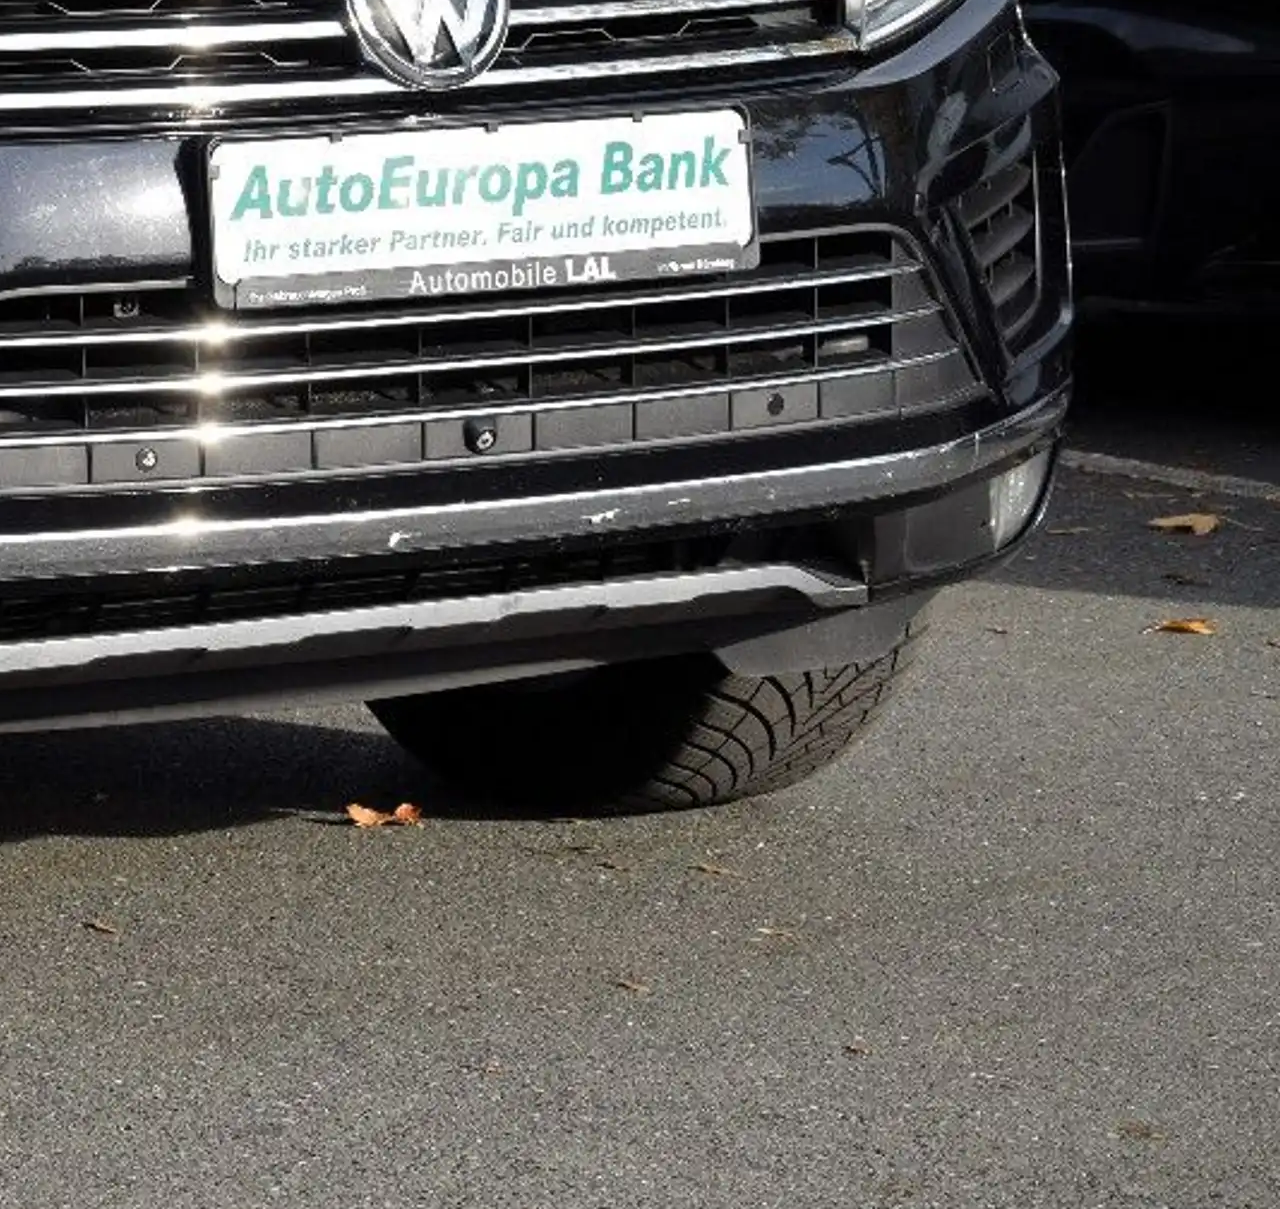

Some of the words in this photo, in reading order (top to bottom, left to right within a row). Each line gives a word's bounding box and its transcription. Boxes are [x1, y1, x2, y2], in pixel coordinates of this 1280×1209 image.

[229, 154, 581, 221] AutoEuropa
[600, 135, 732, 195] Bank
[243, 239, 281, 263] Ihr
[288, 234, 382, 261] starker
[390, 229, 488, 252] Partner.
[497, 220, 544, 244] Fair
[550, 215, 596, 240] und
[602, 207, 728, 239] kompetent.
[408, 263, 558, 295] Automobile
[564, 256, 618, 283] LAL
